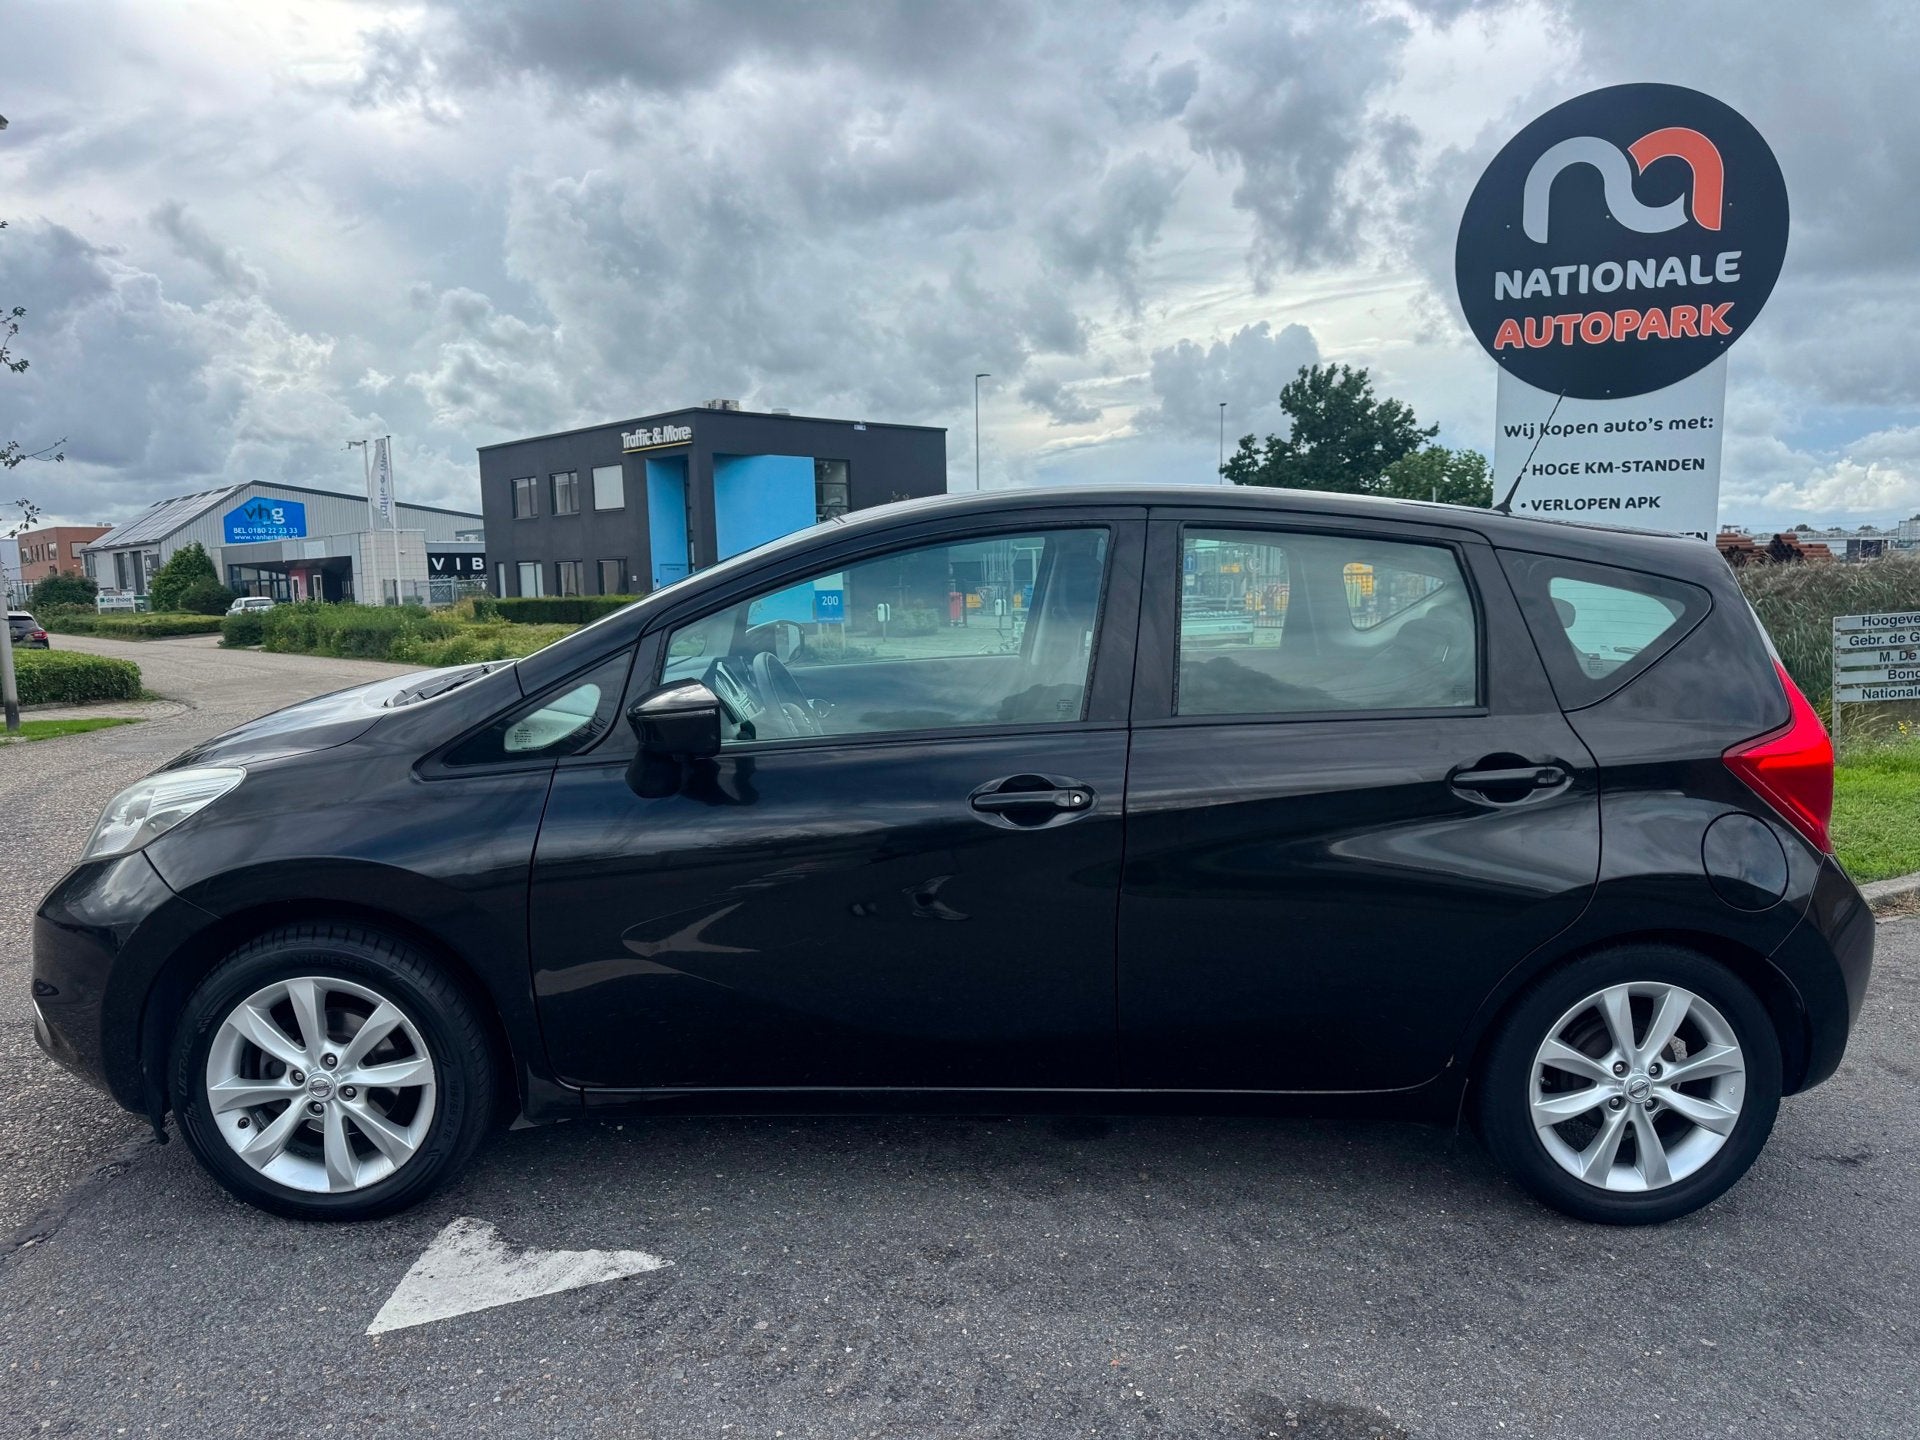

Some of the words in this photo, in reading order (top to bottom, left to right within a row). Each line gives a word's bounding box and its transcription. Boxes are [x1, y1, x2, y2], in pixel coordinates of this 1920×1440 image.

[1494, 251, 1742, 300] NATIONALE
[1494, 302, 1735, 350] AUTOPARK
[621, 429, 653, 448] Traffic
[652, 427, 663, 444] &
[663, 425, 692, 442] More
[1504, 423, 1535, 440] Wij
[1540, 422, 1599, 437] kopen
[1669, 416, 1713, 431] met:
[1532, 462, 1580, 476] HOGE
[1585, 458, 1705, 474] KM-STANDEN
[1531, 497, 1621, 511] VERLOPEN
[1625, 496, 1662, 510] APK
[244, 503, 285, 524] vhg
[822, 596, 839, 606] 200
[1849, 635, 1885, 646] Gebr.
[1889, 633, 1906, 644] de
[1880, 651, 1894, 662] M.
[1899, 651, 1917, 660] De
[1862, 687, 1920, 699] National
